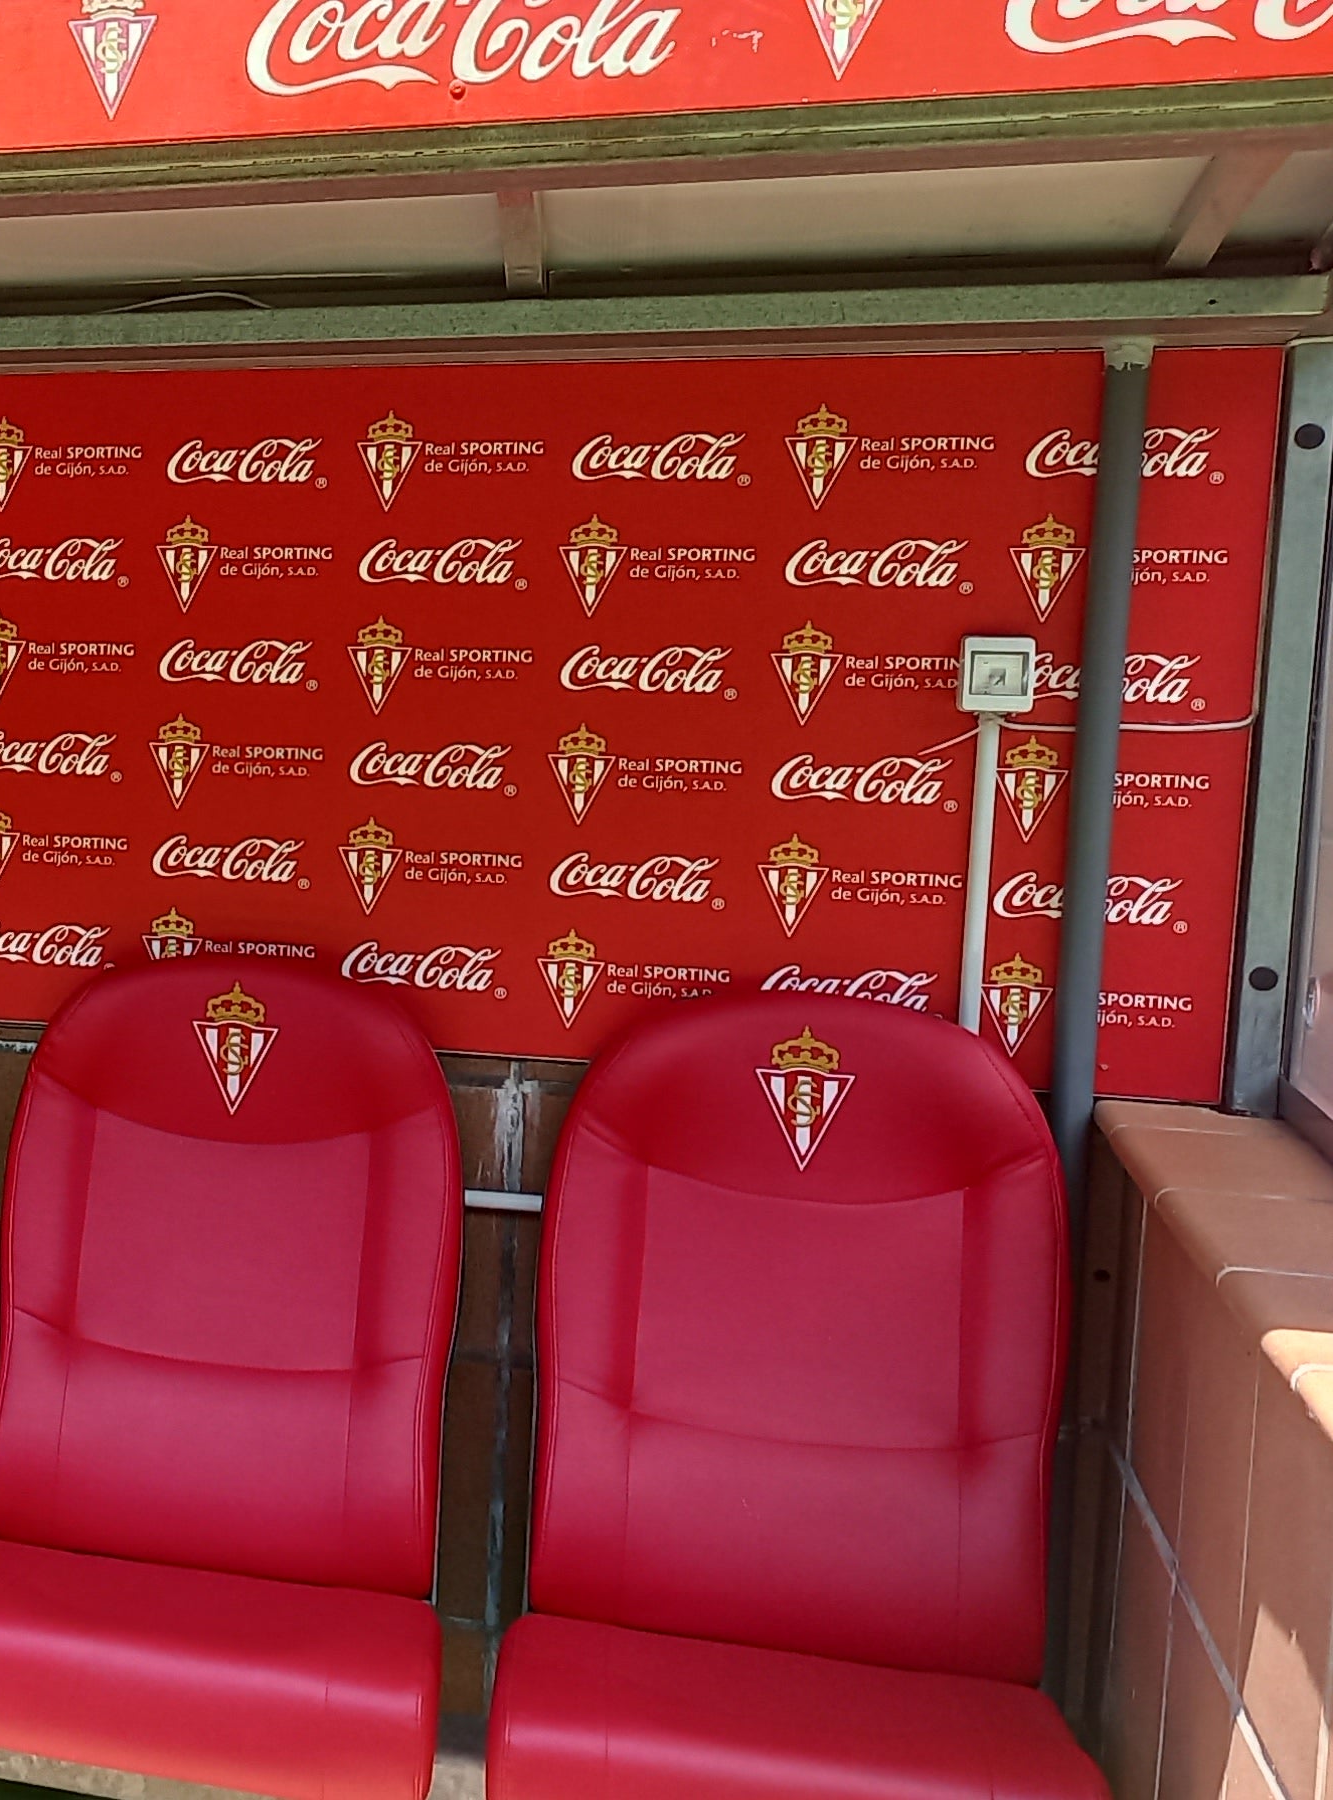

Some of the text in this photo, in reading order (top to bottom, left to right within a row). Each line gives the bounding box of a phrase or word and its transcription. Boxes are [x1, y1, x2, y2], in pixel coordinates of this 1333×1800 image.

[423, 441, 543, 455] Real SPORTING
[861, 437, 994, 451] Real SPORTING
[35, 446, 142, 459] Real SPORTING
[572, 434, 745, 480] Coca-Cola
[167, 439, 322, 483] Coca-Cola
[425, 459, 443, 472] de
[860, 455, 880, 469] de
[35, 463, 51, 475] de
[218, 547, 332, 559] Real SPORTING
[628, 548, 755, 561] Real SPORTING
[1132, 549, 1228, 565] SPORTING
[359, 539, 522, 583] Coca-Cola
[785, 540, 968, 586] Coca-Cola
[220, 563, 238, 575] de
[630, 565, 649, 578] de
[28, 642, 134, 656] Real SPORTING
[415, 648, 532, 663] Real SPORTING
[28, 658, 44, 670] de
[160, 639, 312, 684] Coca-Cola
[560, 646, 732, 692] Coca-Cola
[414, 665, 433, 678] de
[350, 742, 511, 789] Coca-Cola
[616, 757, 741, 774] Real SPORTING
[618, 774, 637, 787] de
[772, 755, 952, 804] Coca-Cola
[1114, 773, 1210, 790] SPORTING
[153, 835, 304, 882] Coca-Cola
[405, 851, 522, 867] Real SPORTING
[405, 867, 423, 880] de
[550, 853, 719, 902] Coca-Cola
[342, 942, 501, 991] Coca-Cola
